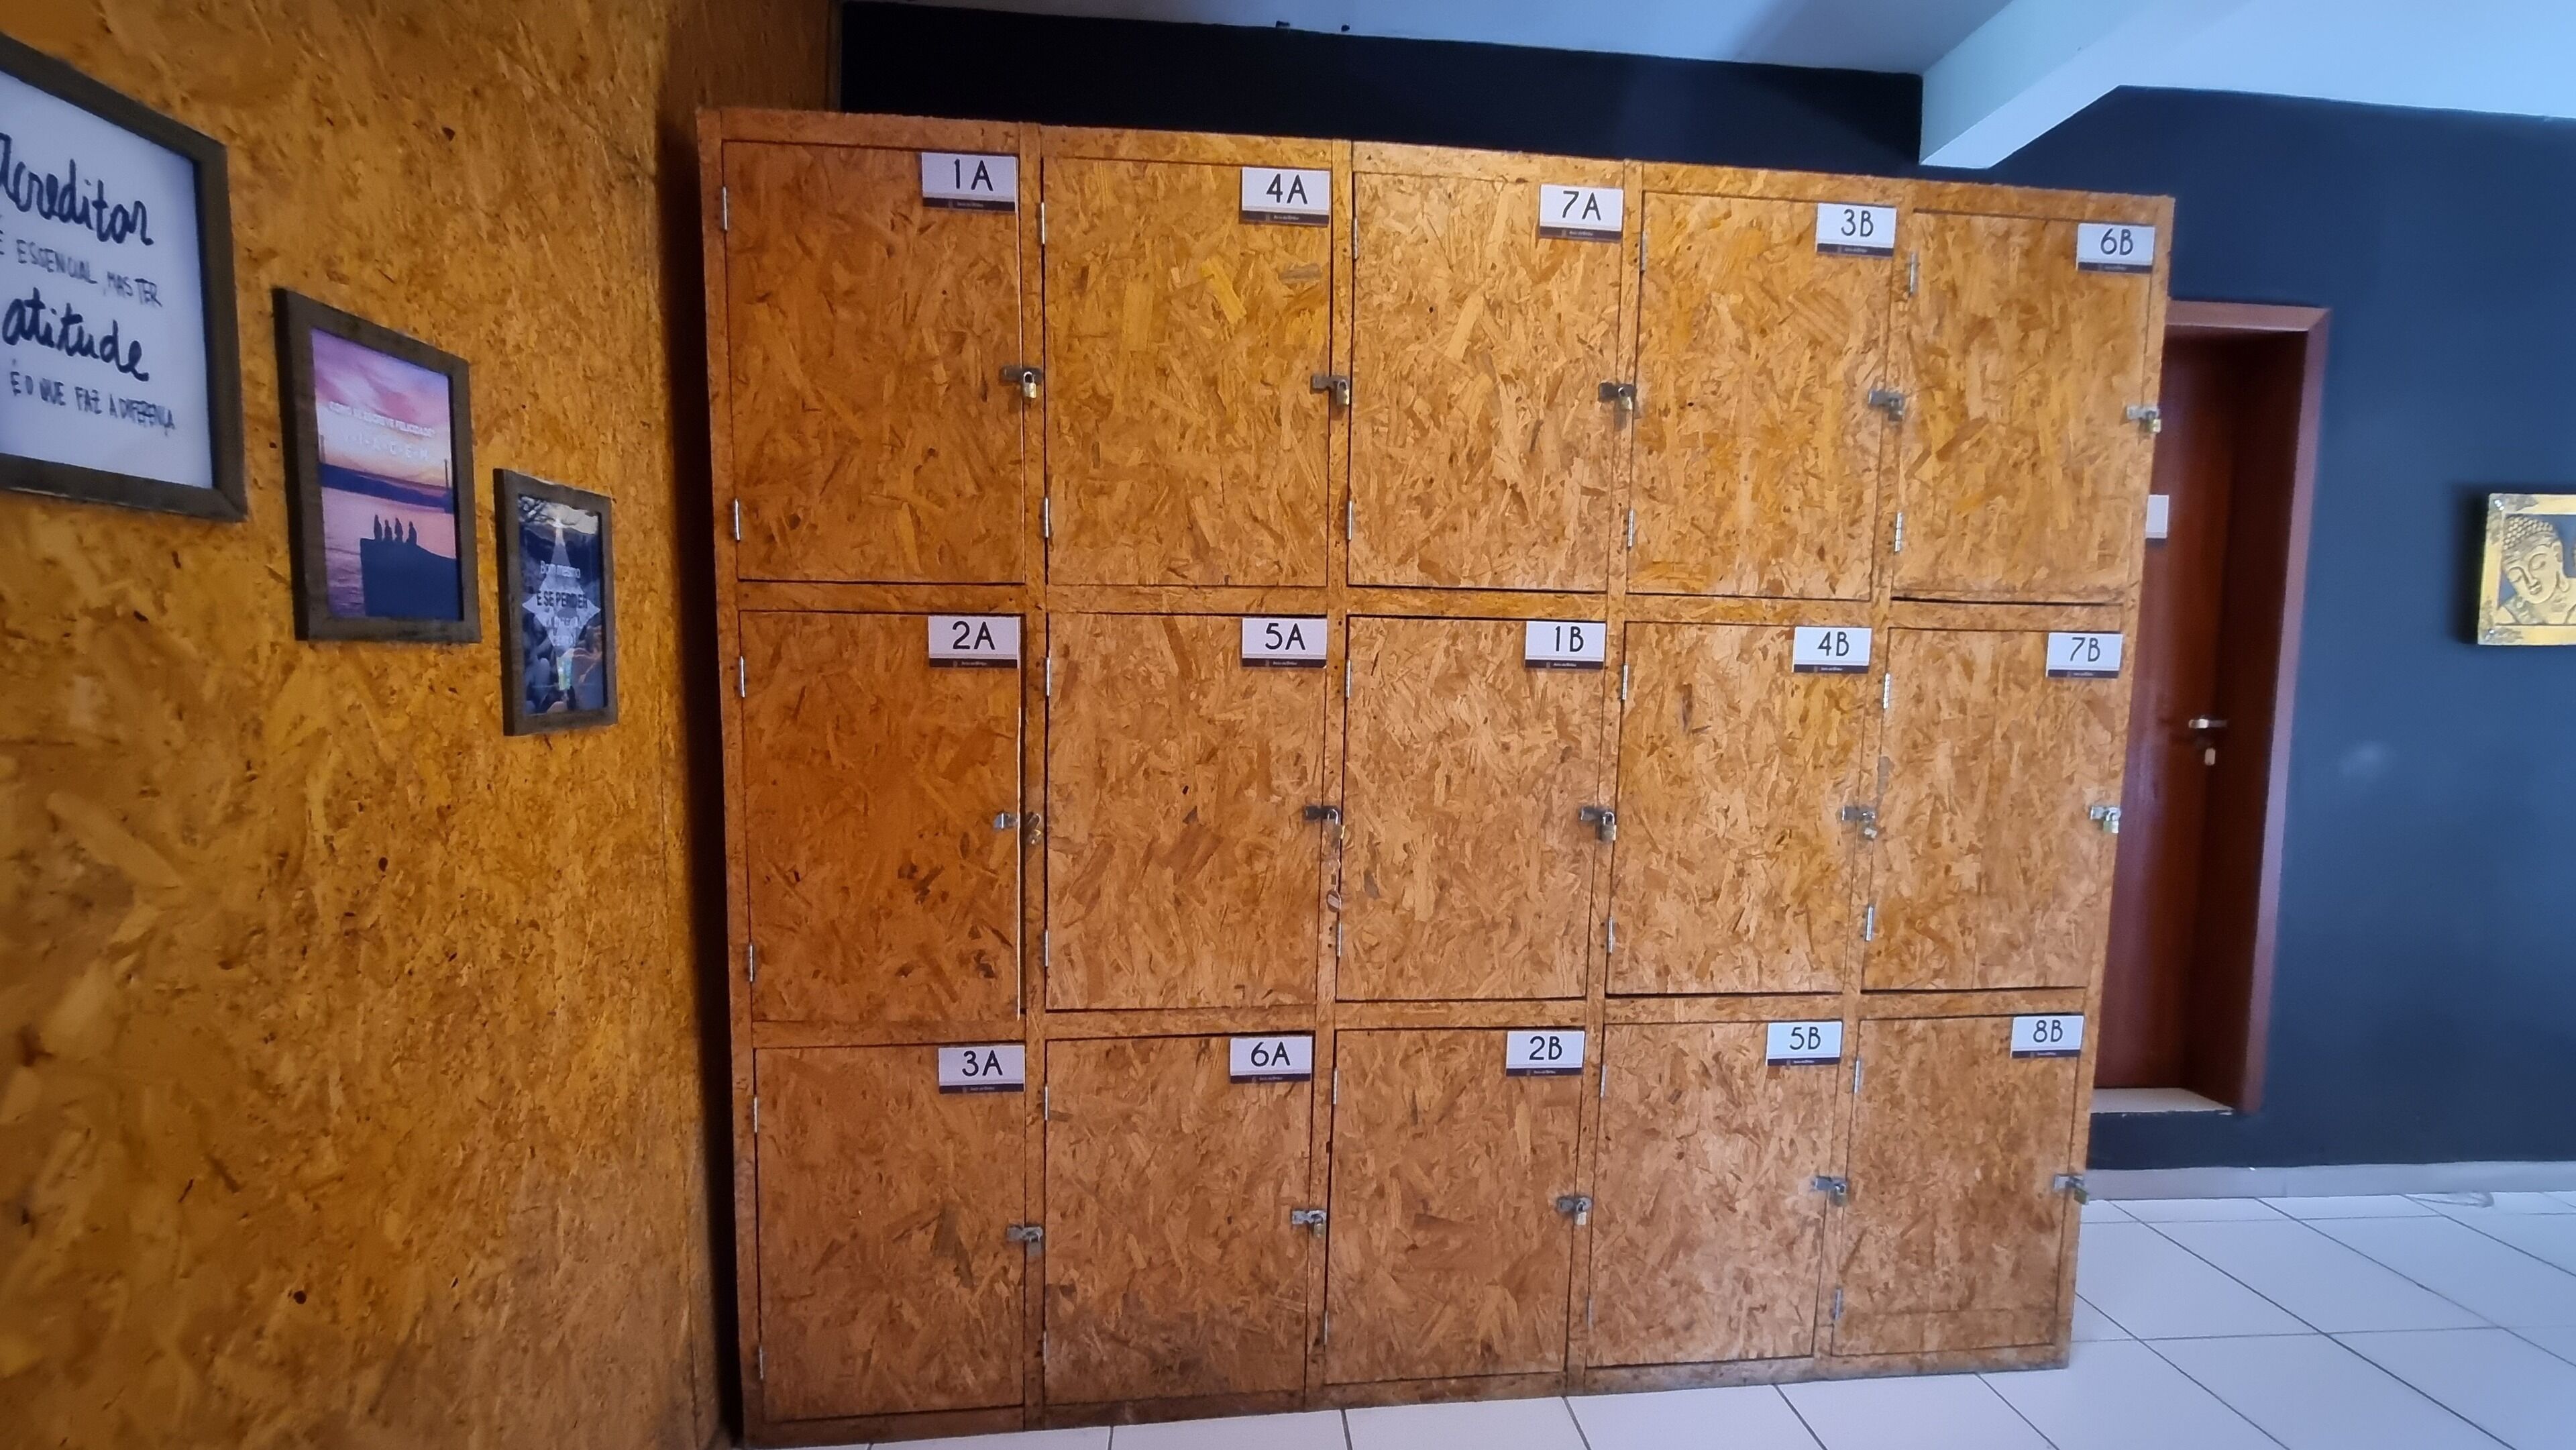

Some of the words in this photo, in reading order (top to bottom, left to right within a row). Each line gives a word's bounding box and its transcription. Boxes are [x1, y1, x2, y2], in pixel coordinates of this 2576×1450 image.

[954, 158, 994, 192] 1A
[1266, 173, 1307, 205] 4A
[1562, 191, 1601, 221] 7A
[1841, 209, 1874, 237] 3B
[2100, 228, 2133, 256] 6B
[2, 287, 150, 382] atitude
[952, 620, 996, 650] 2A
[1265, 623, 1306, 650] 5A
[1555, 625, 1584, 652] 1B
[1818, 631, 1849, 656] 4B
[2070, 637, 2100, 662] 7B
[1789, 1027, 1821, 1050] 5B
[2033, 1019, 2063, 1043] 8B
[1250, 1041, 1291, 1067] 6A
[1529, 1035, 1562, 1060] 2B
[961, 1049, 1003, 1077] 3A
